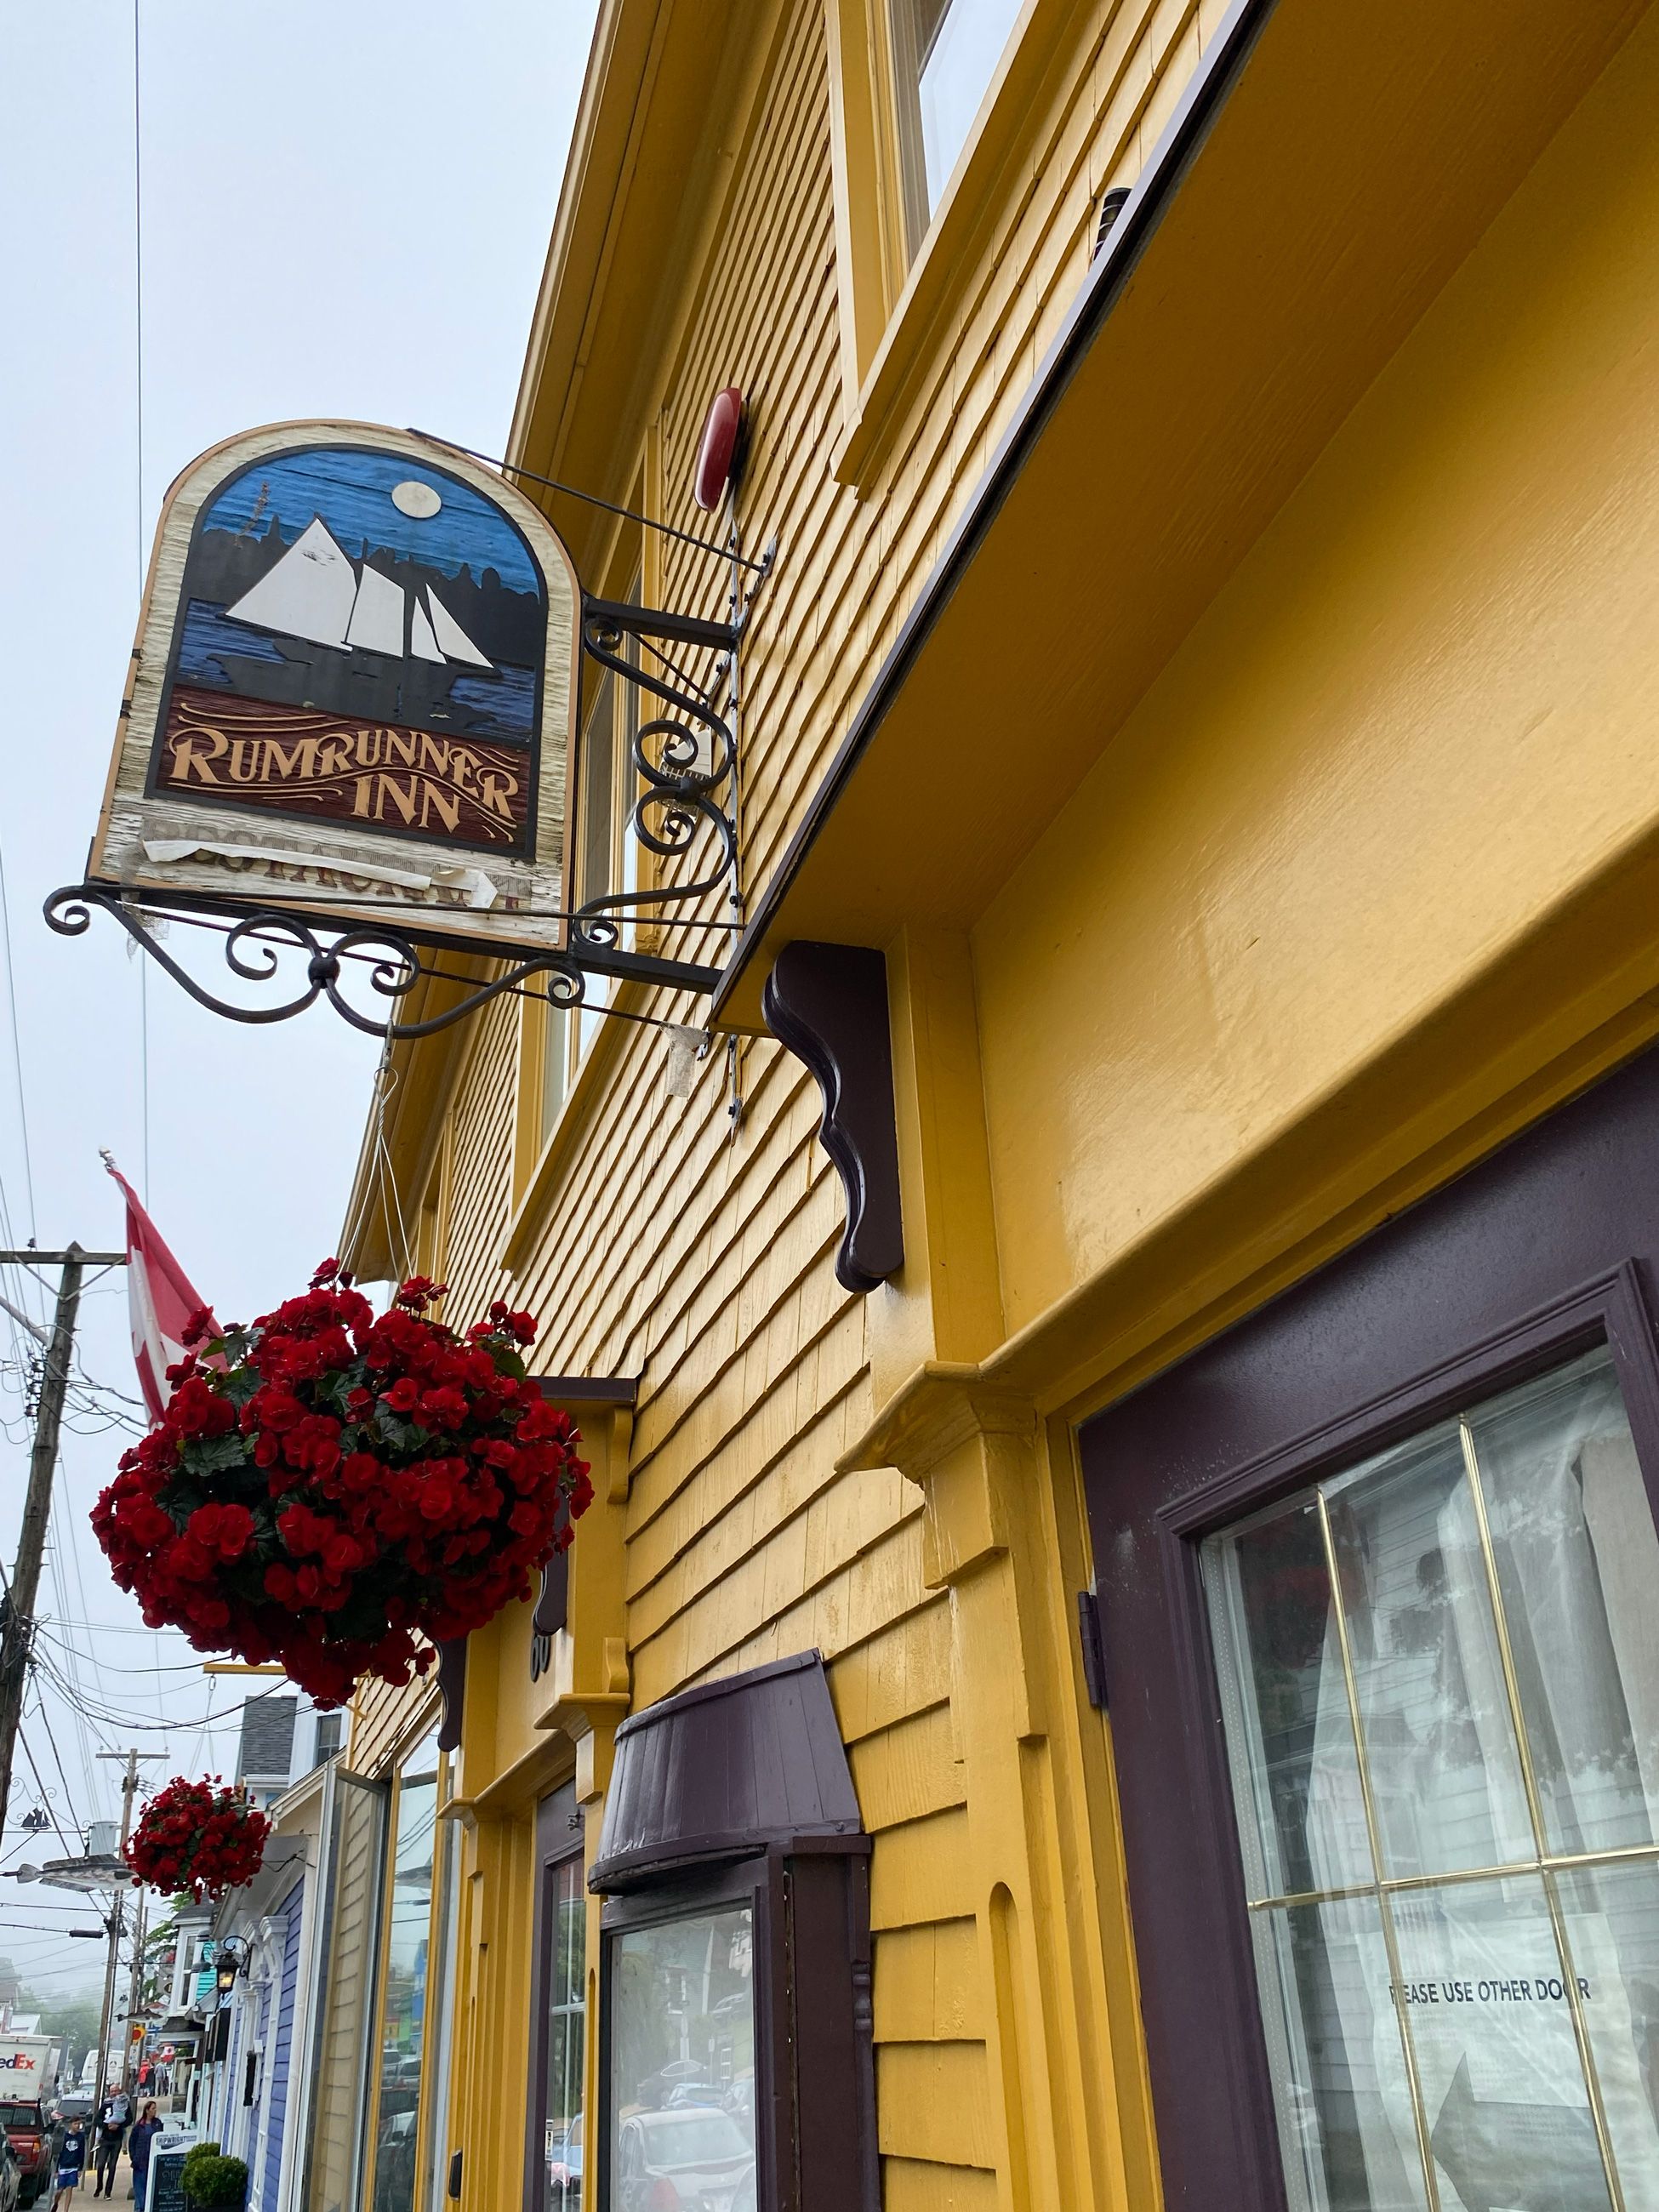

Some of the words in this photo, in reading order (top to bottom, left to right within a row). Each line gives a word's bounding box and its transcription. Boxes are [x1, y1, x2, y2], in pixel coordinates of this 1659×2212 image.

[169, 727, 519, 821] RUMRUNNER
[350, 773, 461, 833] INN
[1388, 1983, 1440, 2004] EASE
[1441, 1981, 1474, 2003] USE
[1478, 1979, 1532, 2002] OTHER
[1535, 1978, 1592, 2000] DOR
